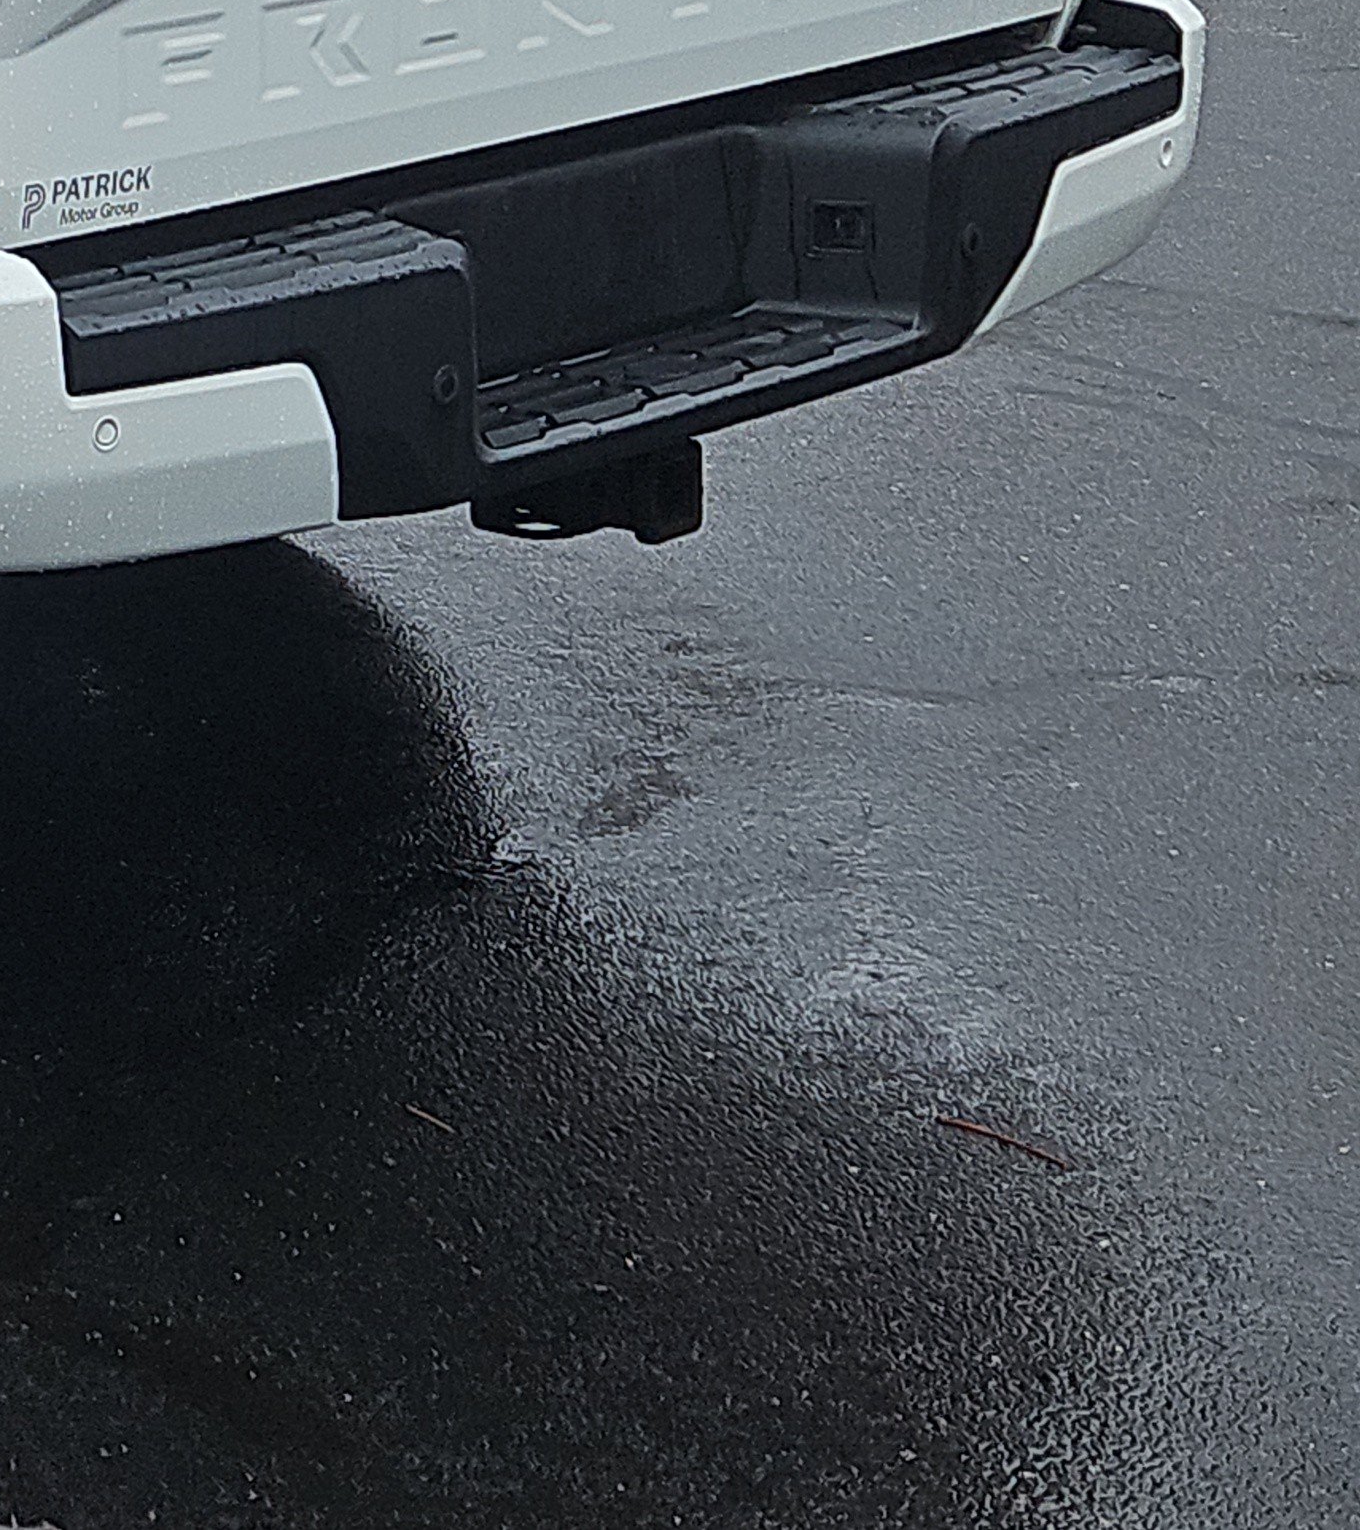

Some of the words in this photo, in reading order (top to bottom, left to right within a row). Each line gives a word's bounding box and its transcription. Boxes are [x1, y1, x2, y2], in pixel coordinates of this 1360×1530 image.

[52, 165, 152, 204] PATRICK
[59, 206, 98, 226] Motor
[100, 201, 139, 220] Group
